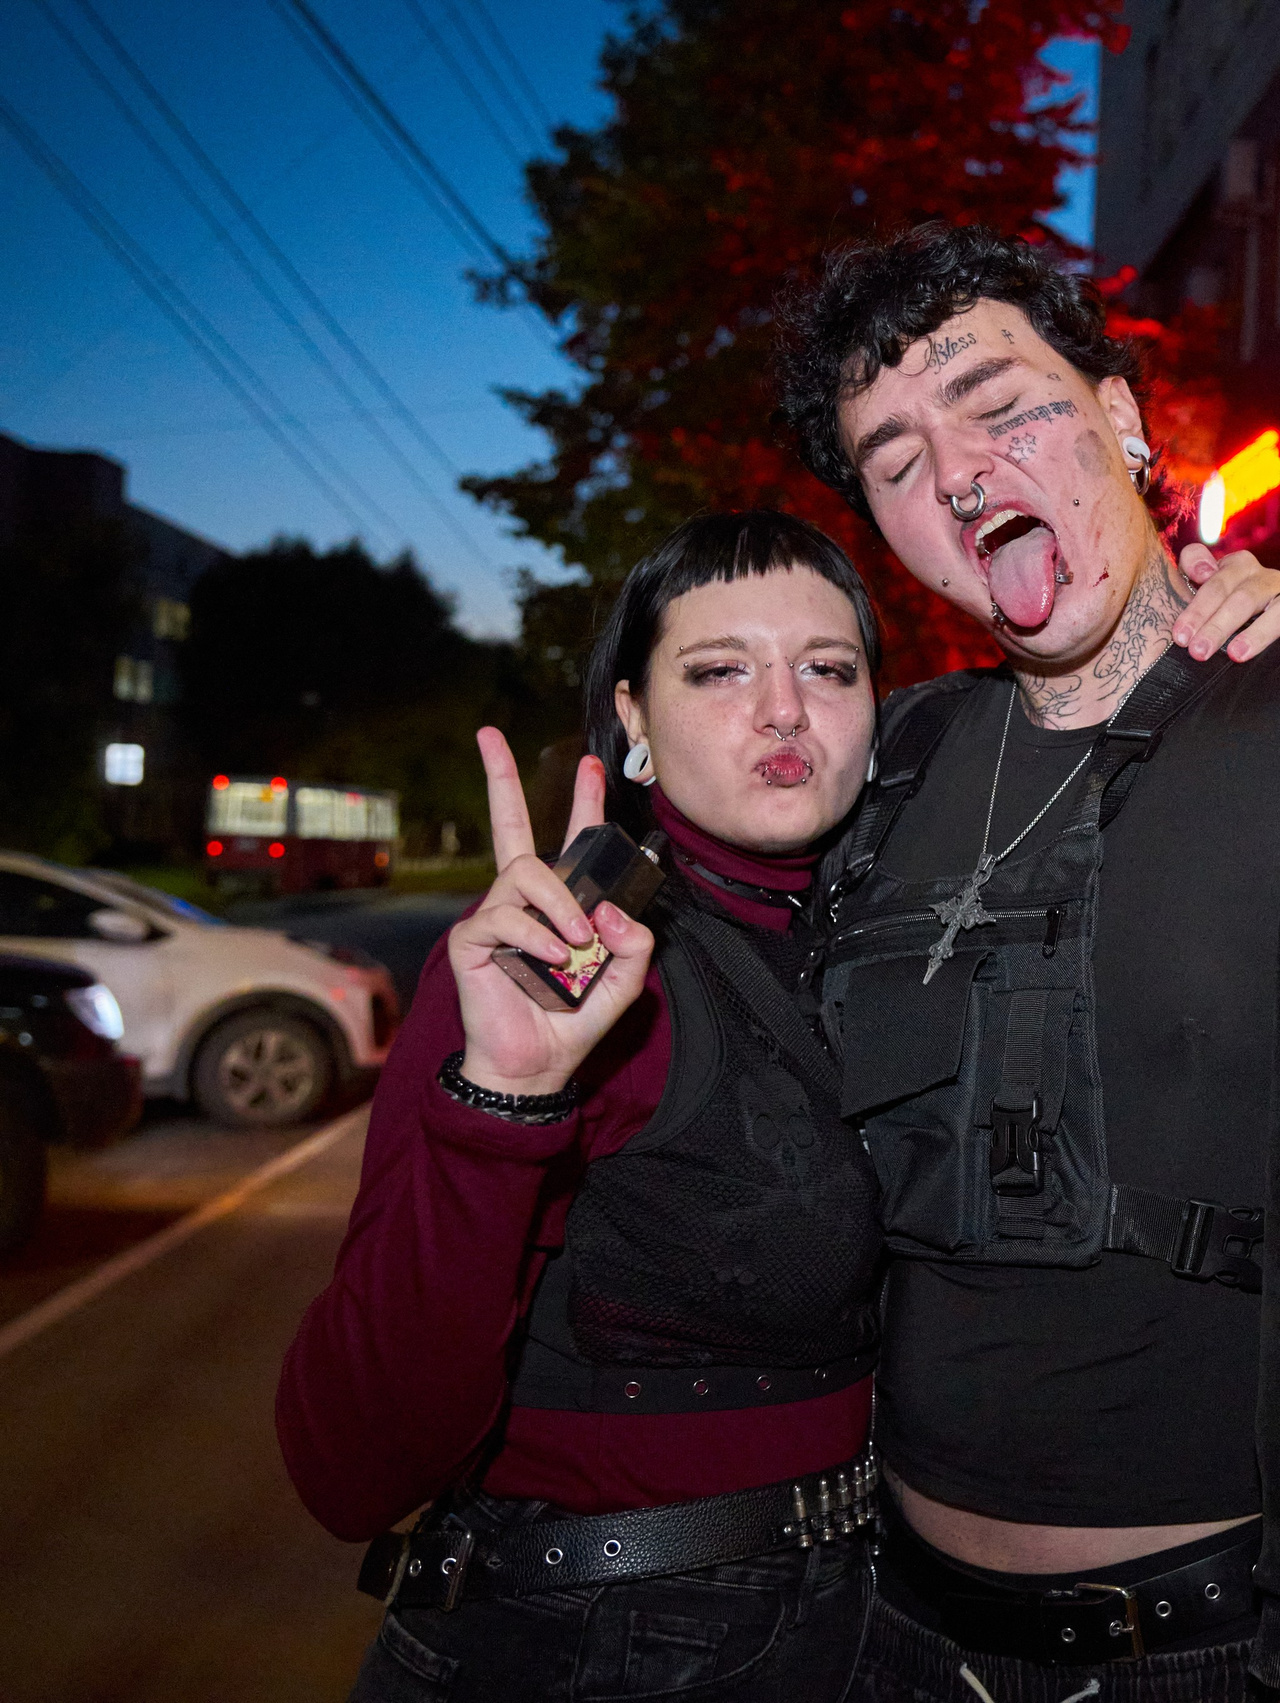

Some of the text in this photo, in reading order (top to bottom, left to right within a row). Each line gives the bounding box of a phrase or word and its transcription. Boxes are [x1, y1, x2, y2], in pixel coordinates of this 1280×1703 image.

[925, 332, 977, 375] Bless
[986, 398, 1079, 441] this user is an angel
